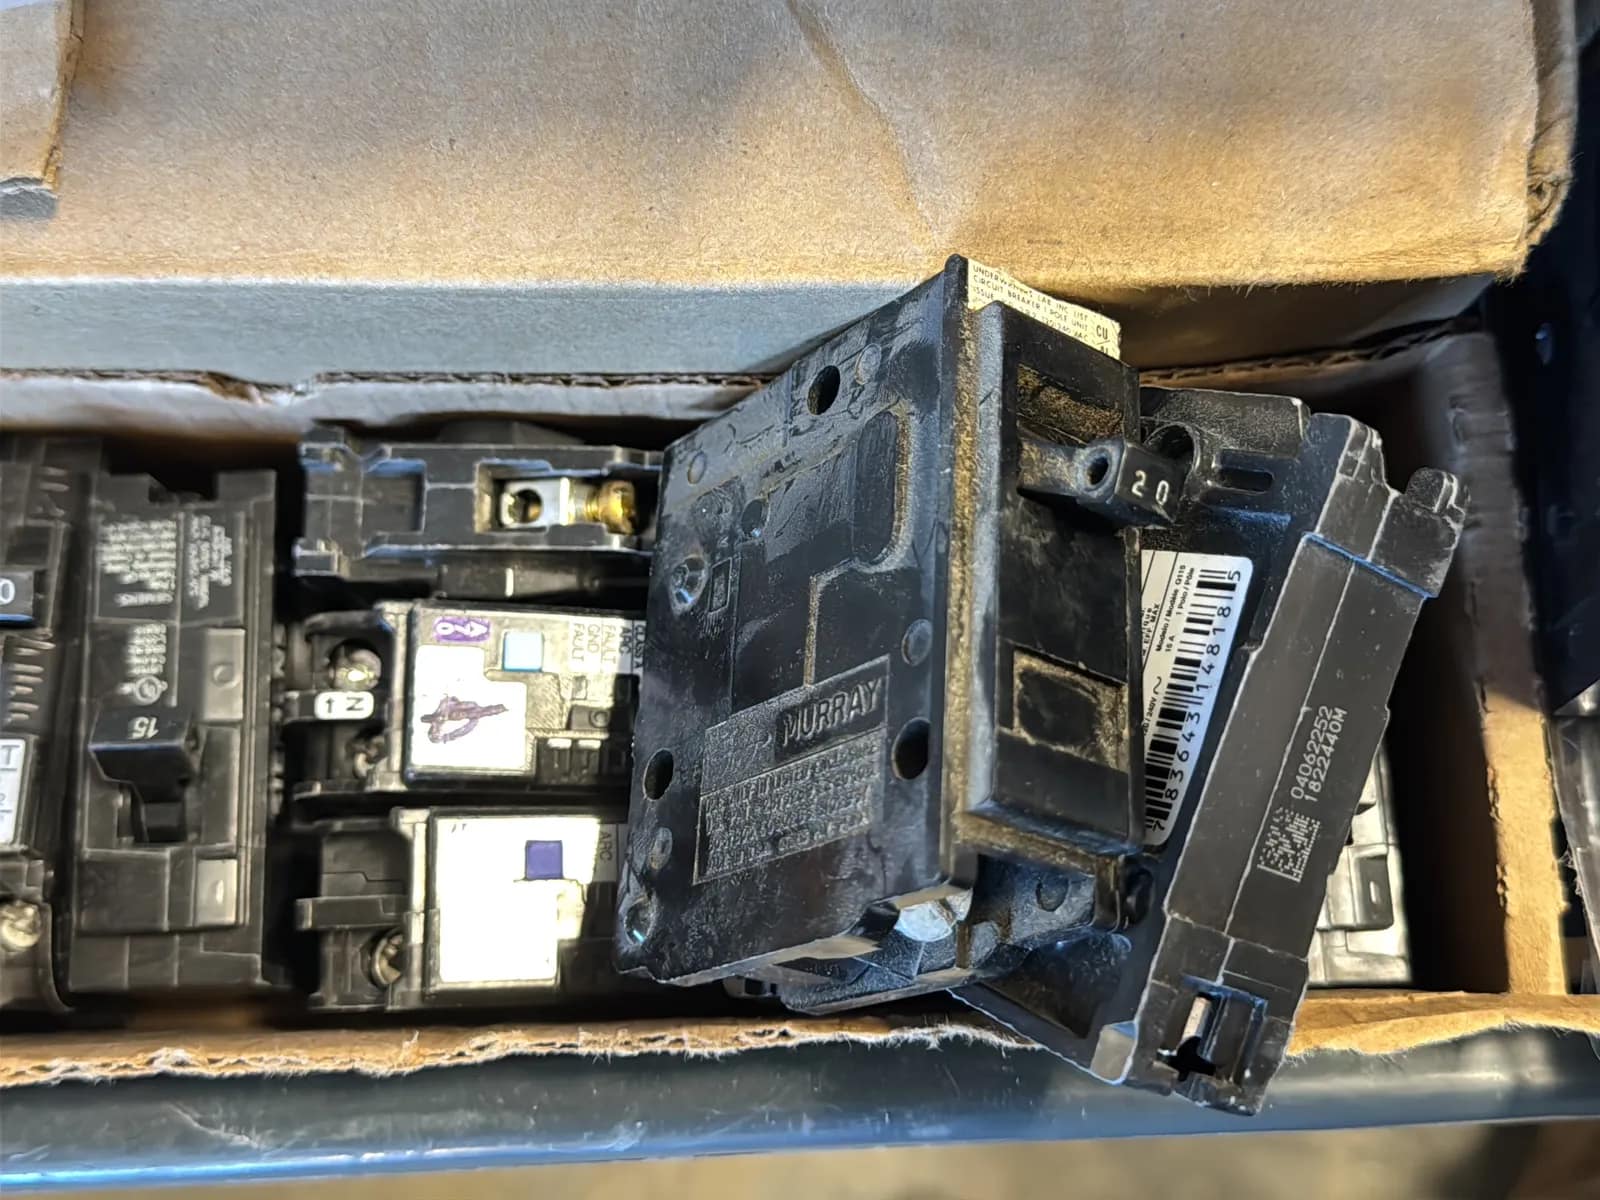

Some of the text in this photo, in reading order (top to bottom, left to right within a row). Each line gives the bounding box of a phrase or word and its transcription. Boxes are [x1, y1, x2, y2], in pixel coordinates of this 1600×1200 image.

[973, 275, 1004, 294] CIRCUIT
[1008, 289, 1041, 311] BREAKER
[1096, 325, 1109, 340] CU
[1132, 470, 1169, 506] 20
[572, 623, 584, 661] FAULT
[1165, 712, 1200, 800] 83643
[1196, 606, 1231, 692] 14818
[1228, 570, 1241, 582] 5
[783, 678, 882, 747] MURRAY
[1291, 706, 1332, 800] 04062252
